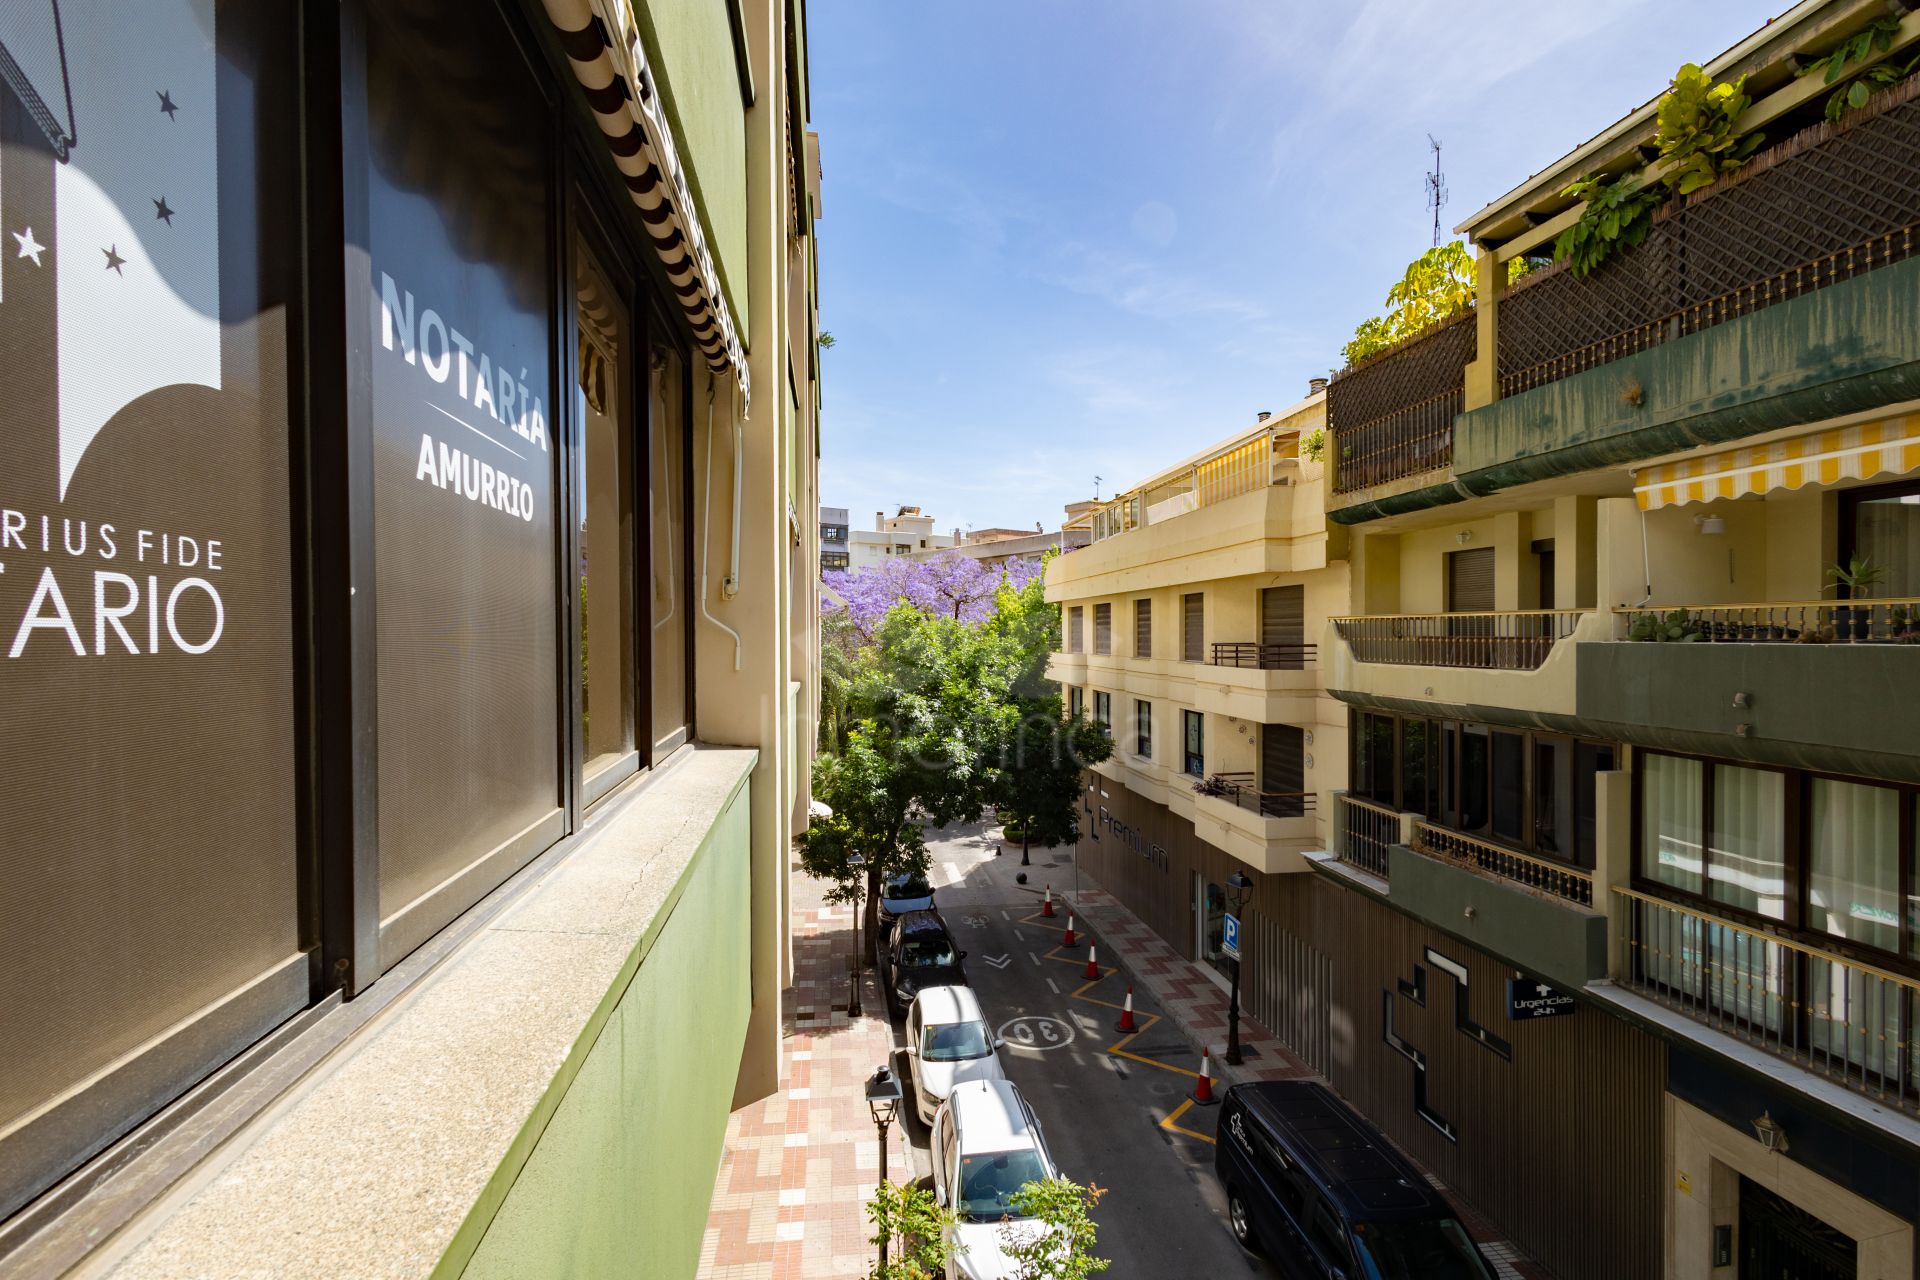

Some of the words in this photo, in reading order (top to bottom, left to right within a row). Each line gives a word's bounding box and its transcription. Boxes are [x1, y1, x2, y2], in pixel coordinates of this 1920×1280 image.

[381, 271, 547, 452] NOTARÍA
[416, 433, 534, 521] AMURRIO
[138, 530, 222, 570] FIDE
[0, 562, 224, 658] ARIO
[1226, 918, 1236, 941] P
[1514, 996, 1574, 1009] Urgencias
[1533, 1007, 1556, 1016] 24h
[1013, 1021, 1059, 1044] 30
